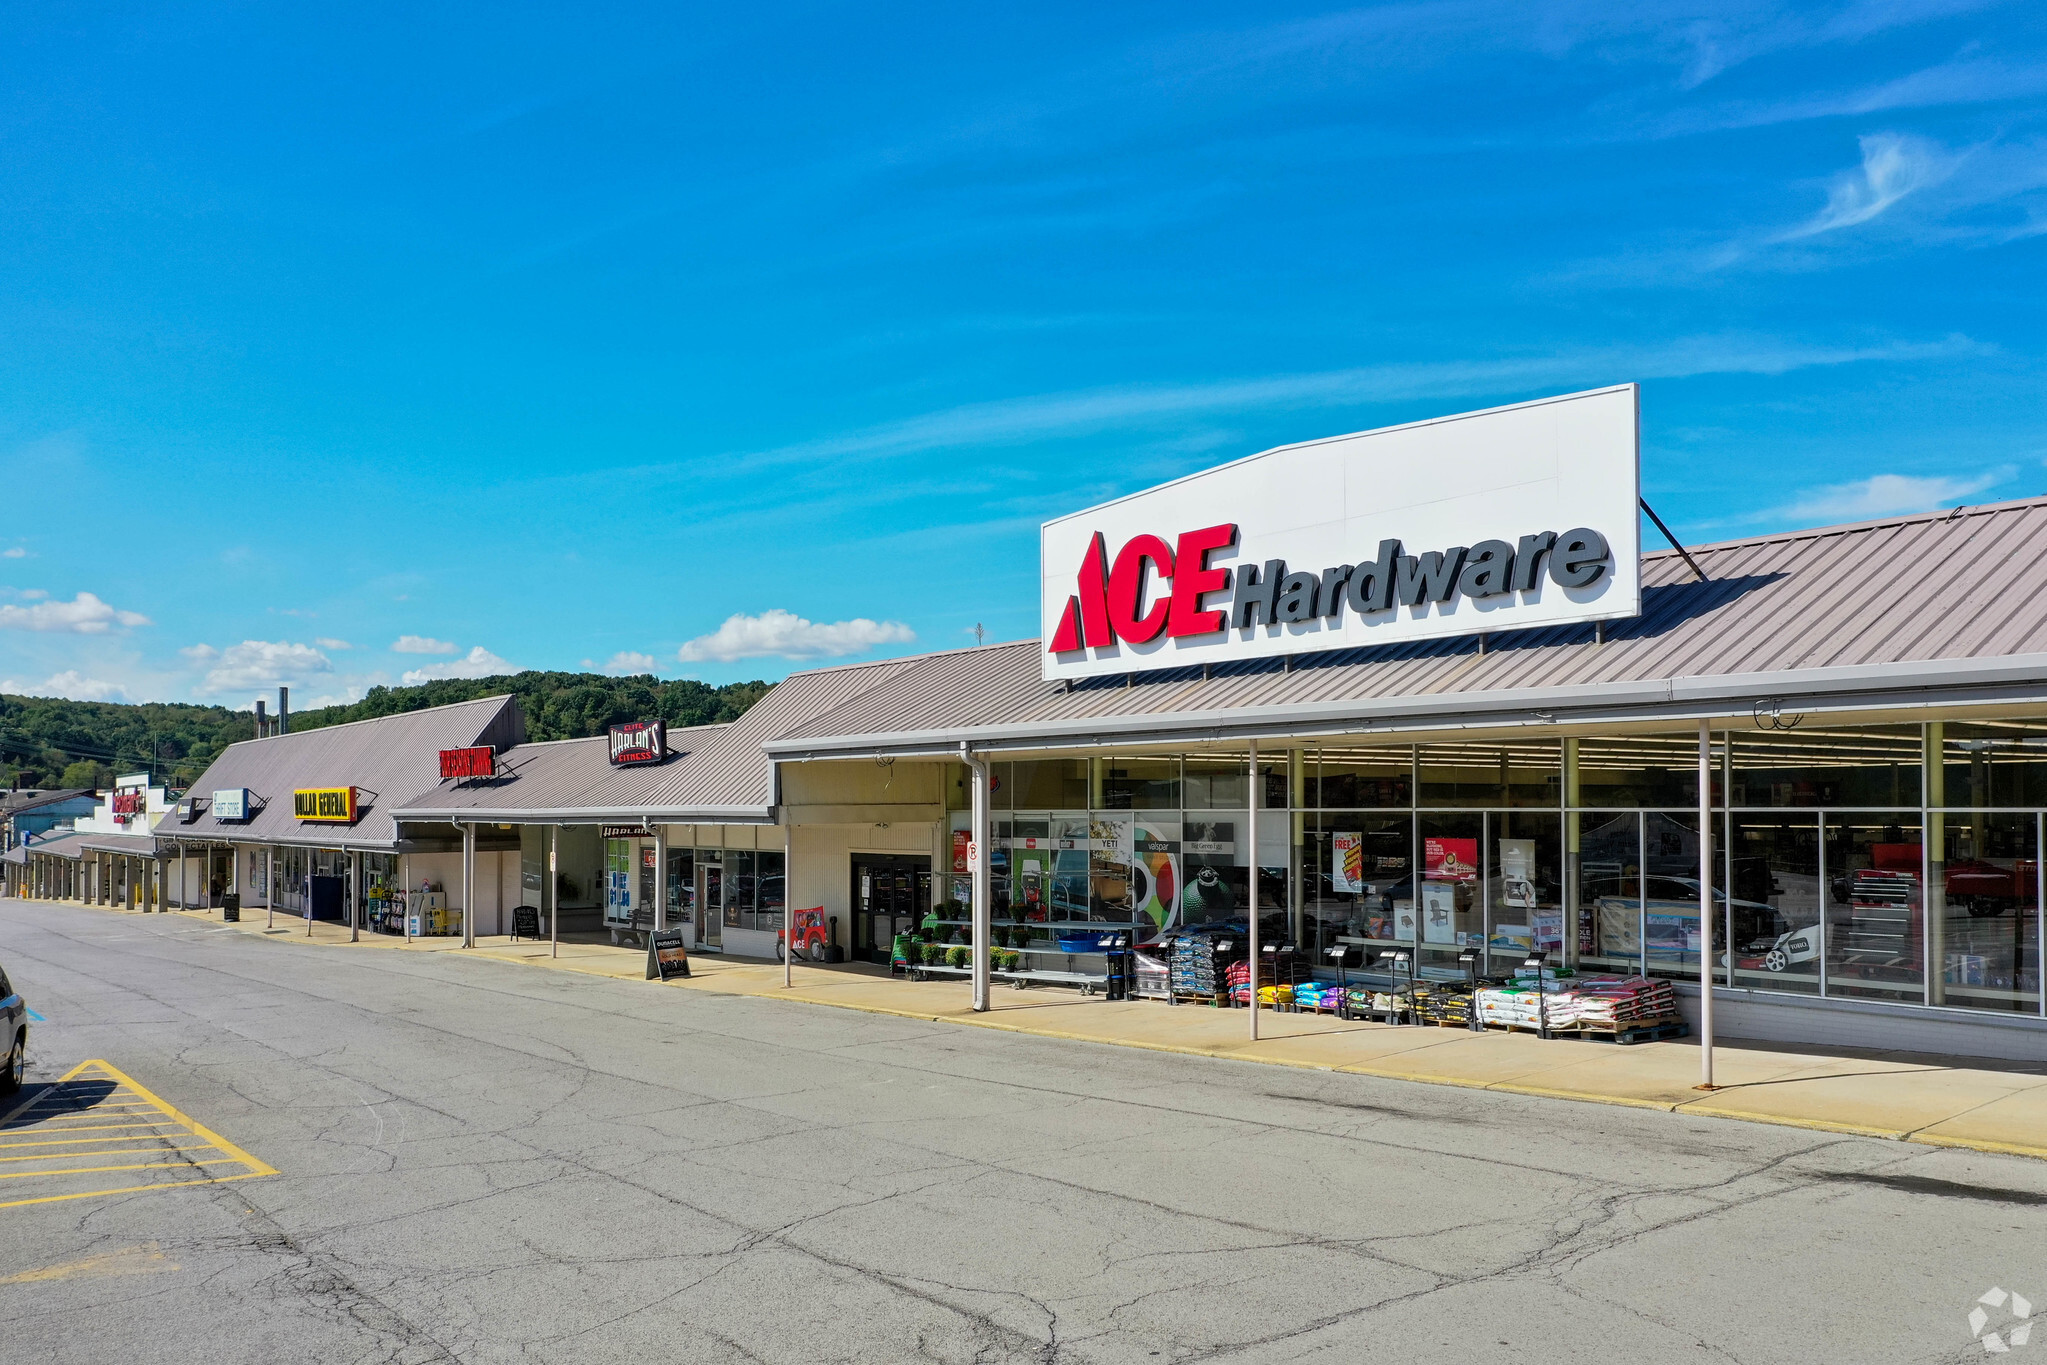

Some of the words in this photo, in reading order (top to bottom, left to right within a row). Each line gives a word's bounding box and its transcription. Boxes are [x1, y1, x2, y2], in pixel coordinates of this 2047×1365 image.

[1048, 523, 1238, 653] ACE
[1231, 526, 1617, 629] Hardware
[624, 723, 644, 731] ELITE
[611, 723, 659, 760] HARLAN'S
[618, 752, 652, 762] FITNESS
[295, 793, 317, 815] DOLLAR
[319, 792, 347, 816] GENERAL
[603, 826, 649, 837] HARLAN
[1102, 840, 1118, 848] YETI
[1148, 842, 1169, 853] valspar
[1335, 840, 1351, 850] FREE
[793, 940, 805, 949] ACE
[1790, 941, 1808, 950] TORO
